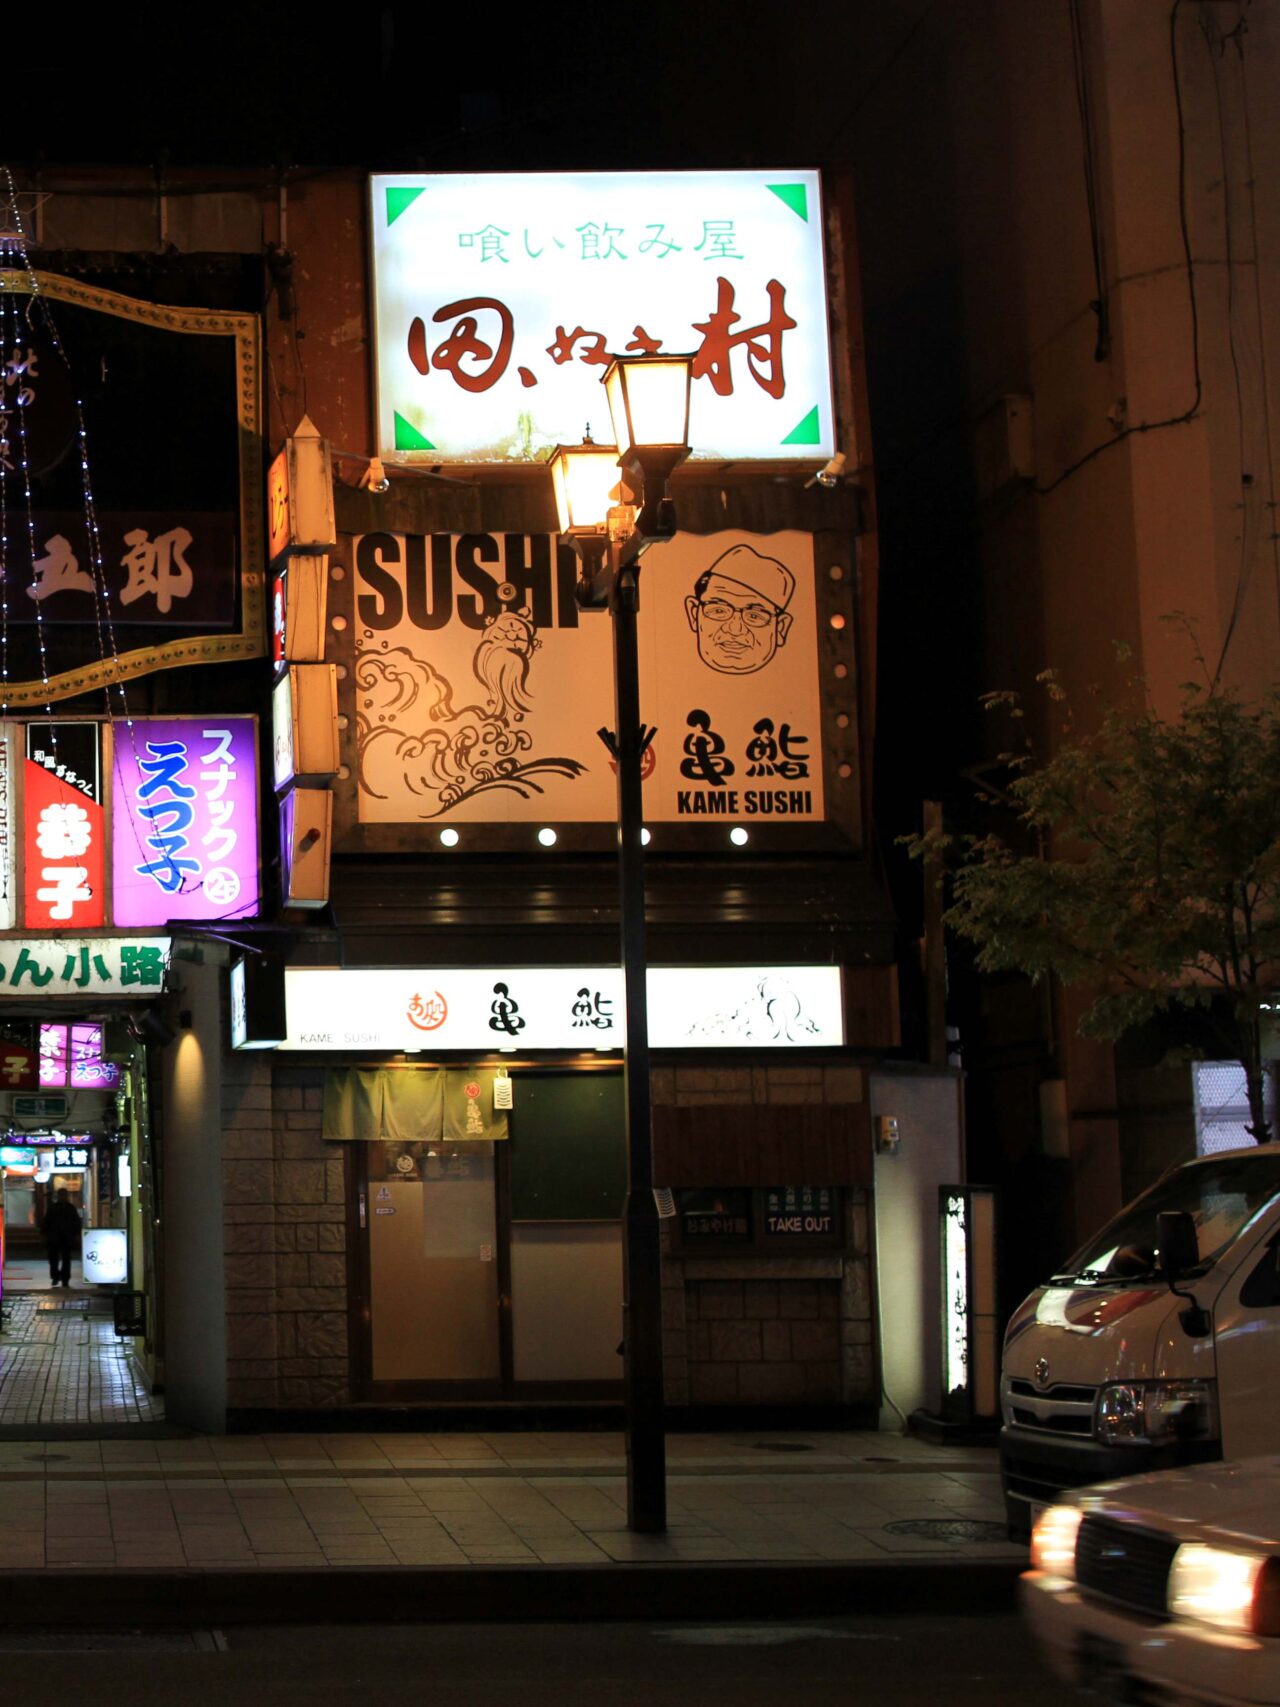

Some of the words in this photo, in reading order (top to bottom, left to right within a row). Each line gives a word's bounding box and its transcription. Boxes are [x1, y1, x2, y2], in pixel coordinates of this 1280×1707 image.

[458, 220, 745, 264] 喰い飲み屋
[356, 533, 579, 631] SUSHI
[200, 728, 237, 864] スナック
[678, 792, 738, 814] KAME
[744, 791, 812, 814] SUSHI
[300, 1033, 333, 1043] KAME
[343, 1033, 381, 1043] SUSHI
[768, 1216, 802, 1232] TAKE
[805, 1216, 831, 1232] OUT
